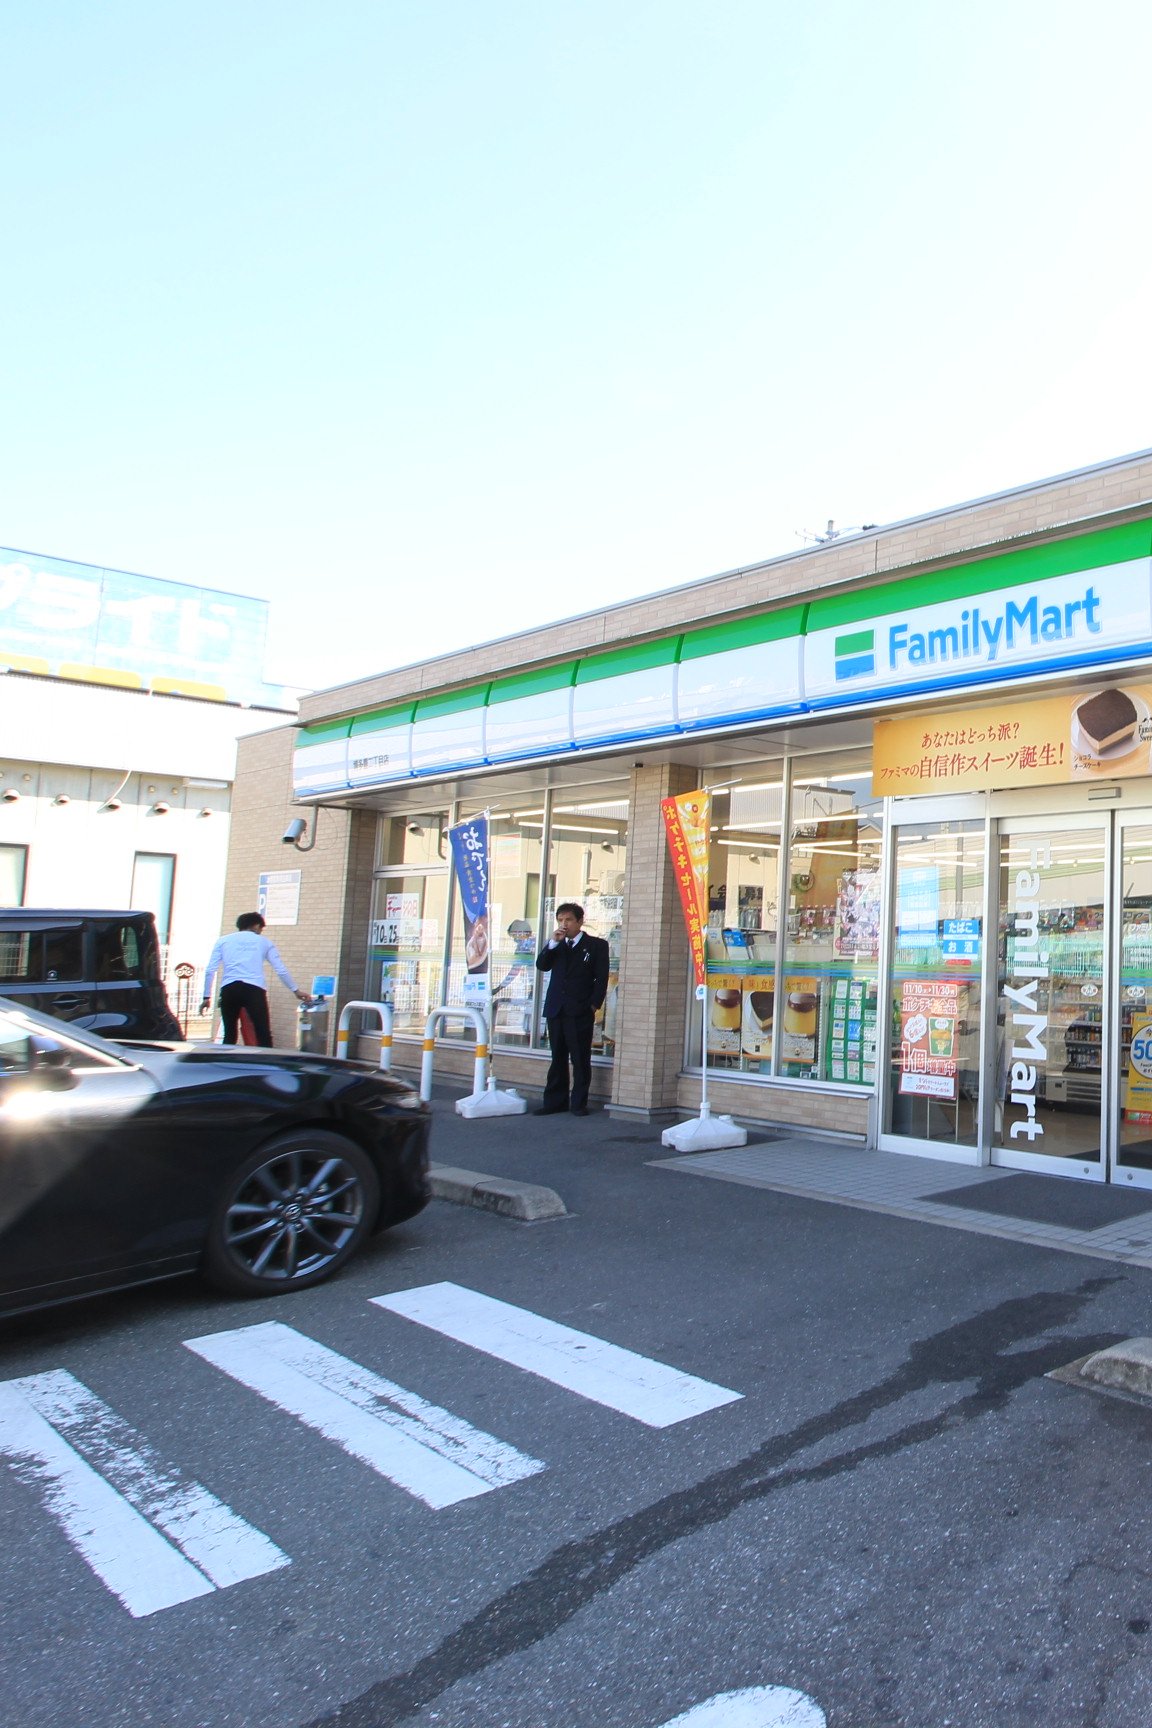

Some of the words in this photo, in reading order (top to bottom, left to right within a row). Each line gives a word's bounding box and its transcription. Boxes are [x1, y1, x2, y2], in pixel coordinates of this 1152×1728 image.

[889, 586, 1102, 671] FamilyMart
[921, 722, 1020, 749] あなたはどっち派?
[880, 742, 1065, 779] ファミマの自信作スイーツ誕生!
[948, 922, 973, 933] たばこ
[948, 941, 973, 952] お酒
[1004, 840, 1051, 1141] FamilyMart
